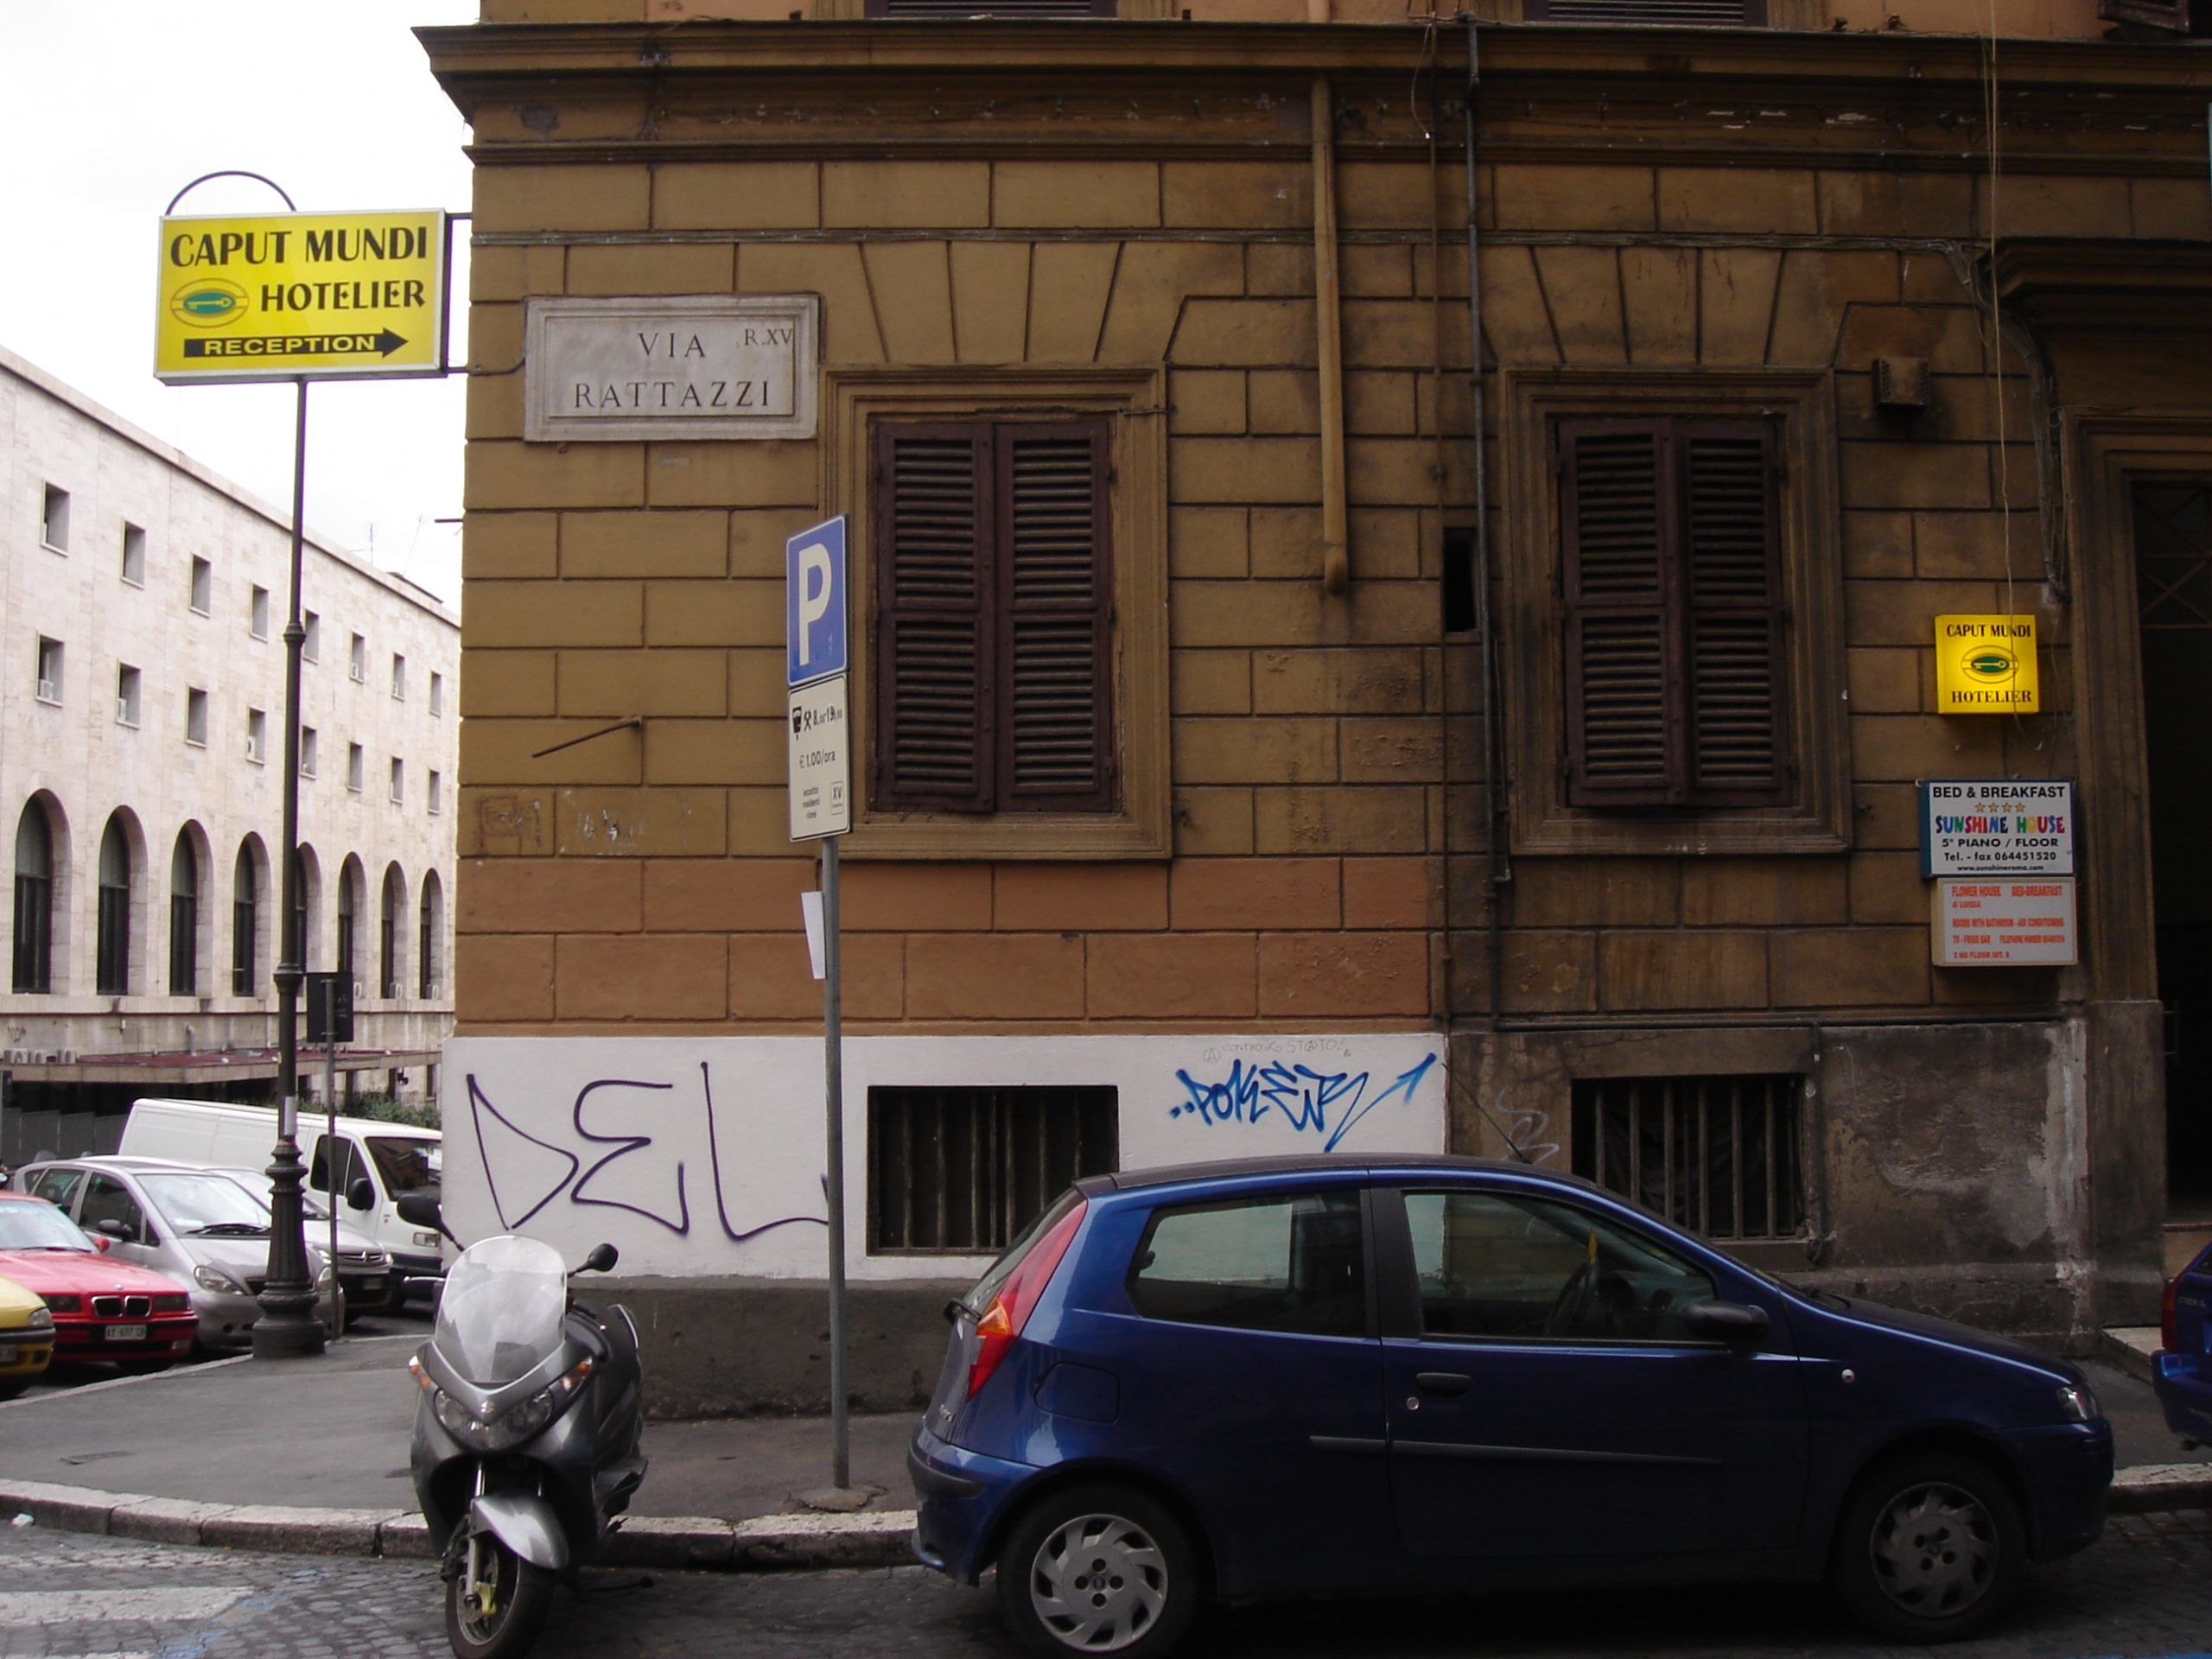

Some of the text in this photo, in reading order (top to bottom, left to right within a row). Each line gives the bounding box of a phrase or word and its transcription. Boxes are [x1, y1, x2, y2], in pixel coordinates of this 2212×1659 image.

[170, 226, 427, 267] CAPUT MUNDI
[261, 279, 425, 312] HOTELIER
[204, 335, 375, 356] RECEPTION
[638, 332, 706, 358] VIA
[575, 381, 769, 409] RATTAZZI
[798, 543, 832, 666] P
[1946, 624, 2031, 638] CAPUT MUNDI
[1951, 690, 2032, 703] HOTELIER
[1933, 786, 2065, 798] BED & BREAKFAST
[1936, 815, 2065, 834] SUNSHINE HOUSE
[1958, 838, 2001, 848] PIANO
[2015, 838, 2058, 848] FLOOR
[1944, 852, 1963, 861] Tel.
[1974, 852, 1992, 861] fax
[1994, 852, 2056, 861] 064451520
